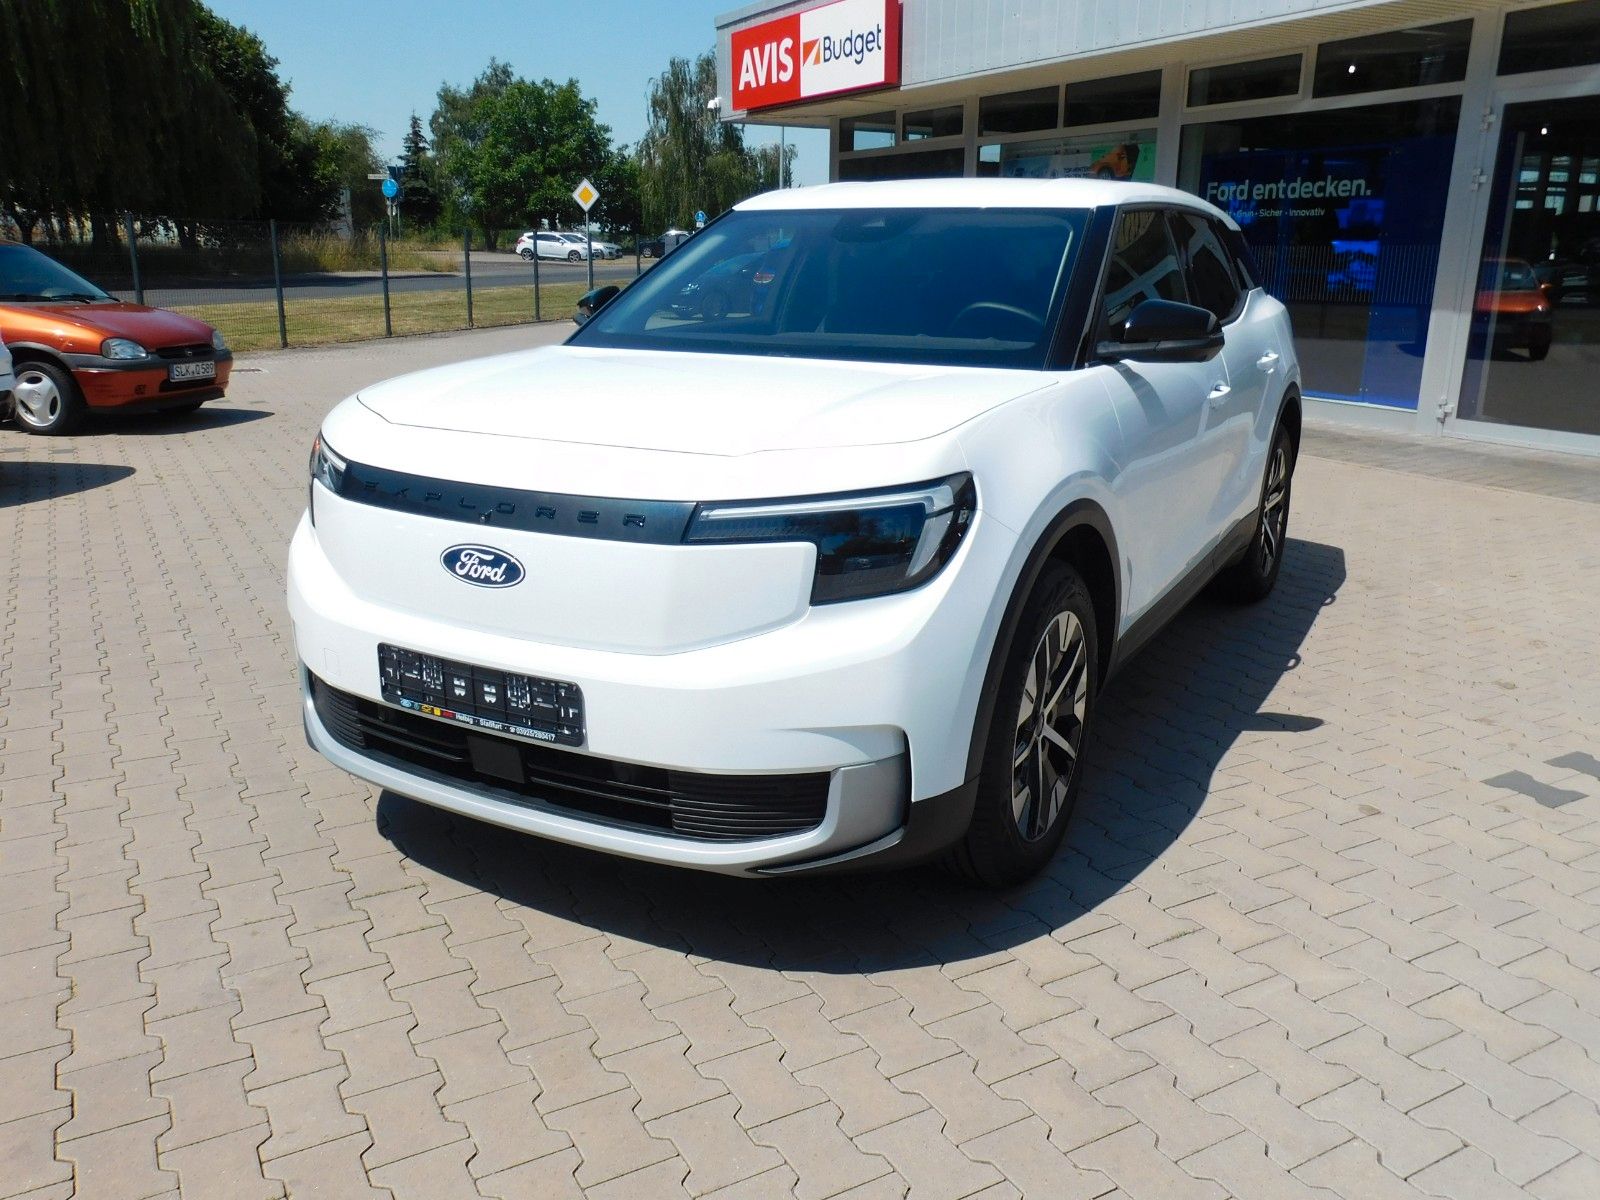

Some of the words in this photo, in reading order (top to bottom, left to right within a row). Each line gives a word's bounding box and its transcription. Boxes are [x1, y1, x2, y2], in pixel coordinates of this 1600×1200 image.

[738, 37, 794, 91] AVIS
[823, 23, 882, 65] Budget
[1206, 179, 1249, 201] Ford
[1252, 175, 1372, 199] entdecken.
[1258, 208, 1283, 218] Sicher
[1289, 207, 1326, 217] Innovativ
[364, 480, 646, 528] EXPLORER
[455, 549, 507, 583] Ford
